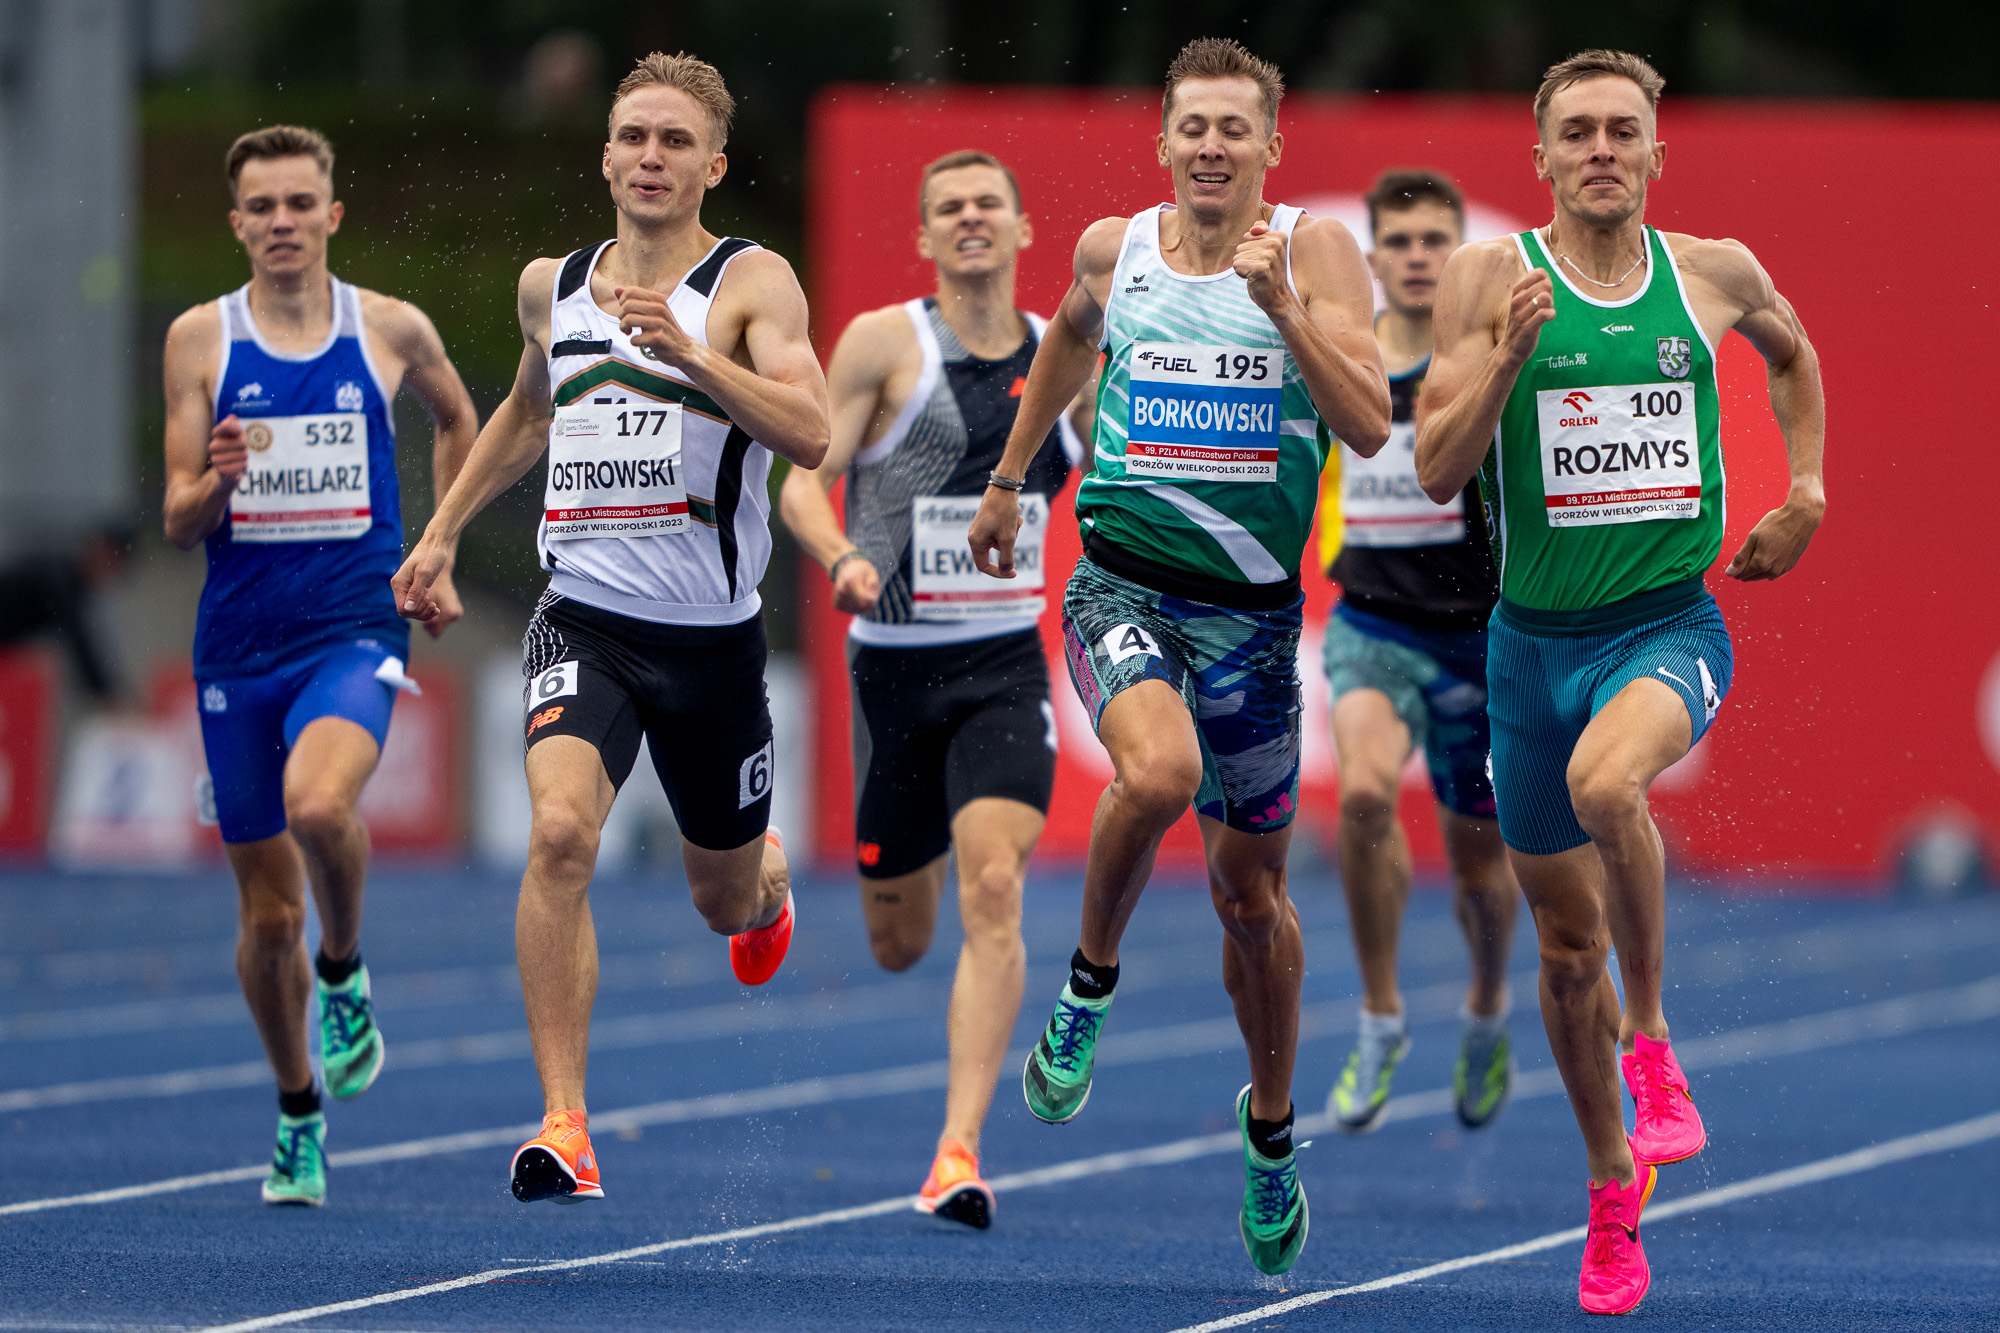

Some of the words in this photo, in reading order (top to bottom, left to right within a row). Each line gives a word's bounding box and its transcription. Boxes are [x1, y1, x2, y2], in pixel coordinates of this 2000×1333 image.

[1125, 285, 1149, 294] erima
[1151, 356, 1197, 373] FUEL
[1215, 353, 1268, 381] 195
[1134, 396, 1274, 432] BORKOWSKI
[1630, 390, 1682, 417] 100
[305, 420, 354, 447] 532
[616, 410, 667, 436] 177
[1559, 416, 1598, 427] ORLEN
[1132, 458, 1174, 470] GORZÓW
[1176, 463, 1245, 474] WIELKOPOLSKI
[1247, 466, 1270, 474] 2023
[1145, 446, 1157, 455] 99.
[1158, 447, 1178, 457] PZLA
[1180, 449, 1231, 460] Mistrzostwa
[1233, 451, 1258, 460] Polski
[1553, 439, 1689, 477] ROZMYS
[553, 459, 675, 491] OSTROWSKI
[1566, 496, 1580, 505] 99.
[1582, 495, 1603, 504] PZLA
[1605, 491, 1659, 502] Mistrzostwa
[1660, 488, 1685, 498] Polski
[559, 511, 570, 519] 99.
[571, 510, 591, 518] PZLA
[592, 508, 641, 517] Mistrzostwa
[643, 506, 668, 515] Polski
[1554, 508, 1600, 520] GORZÓW
[1602, 504, 1674, 517] WIELKOPOLSKI
[1675, 503, 1693, 511] 2023
[549, 523, 588, 534] GORZÓW
[590, 521, 657, 531] WIELKOPOLSKI
[659, 518, 683, 528] 2023
[1119, 626, 1151, 652] 4
[538, 666, 565, 698] 6
[748, 753, 768, 797] 6
